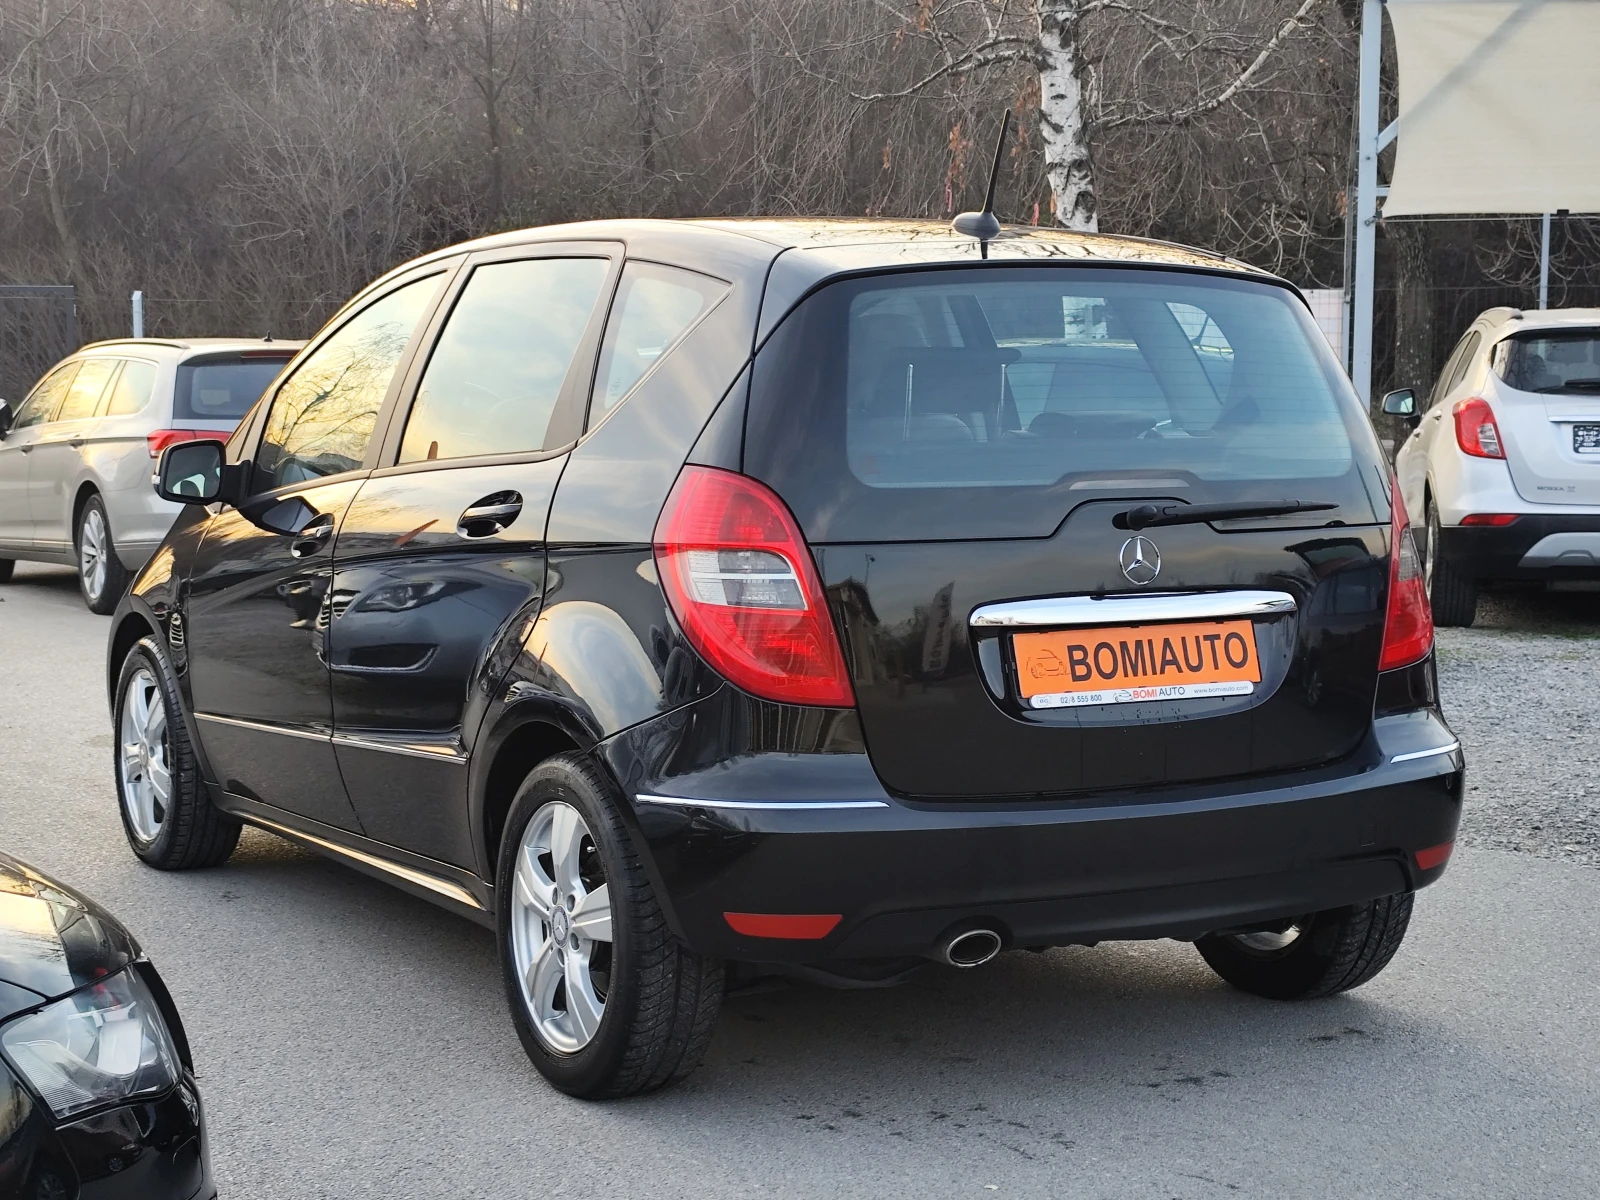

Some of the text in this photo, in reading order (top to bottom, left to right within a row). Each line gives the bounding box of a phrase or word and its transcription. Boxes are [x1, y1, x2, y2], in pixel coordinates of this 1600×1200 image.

[1067, 631, 1249, 682] BOMIAUTO
[1060, 696, 1075, 704] 02/8
[1077, 695, 1089, 703] 555
[1090, 694, 1102, 702] 800
[1132, 688, 1157, 699] BOMI
[1158, 686, 1186, 696] AUTO
[1193, 685, 1249, 694] www.bomiauto.com
